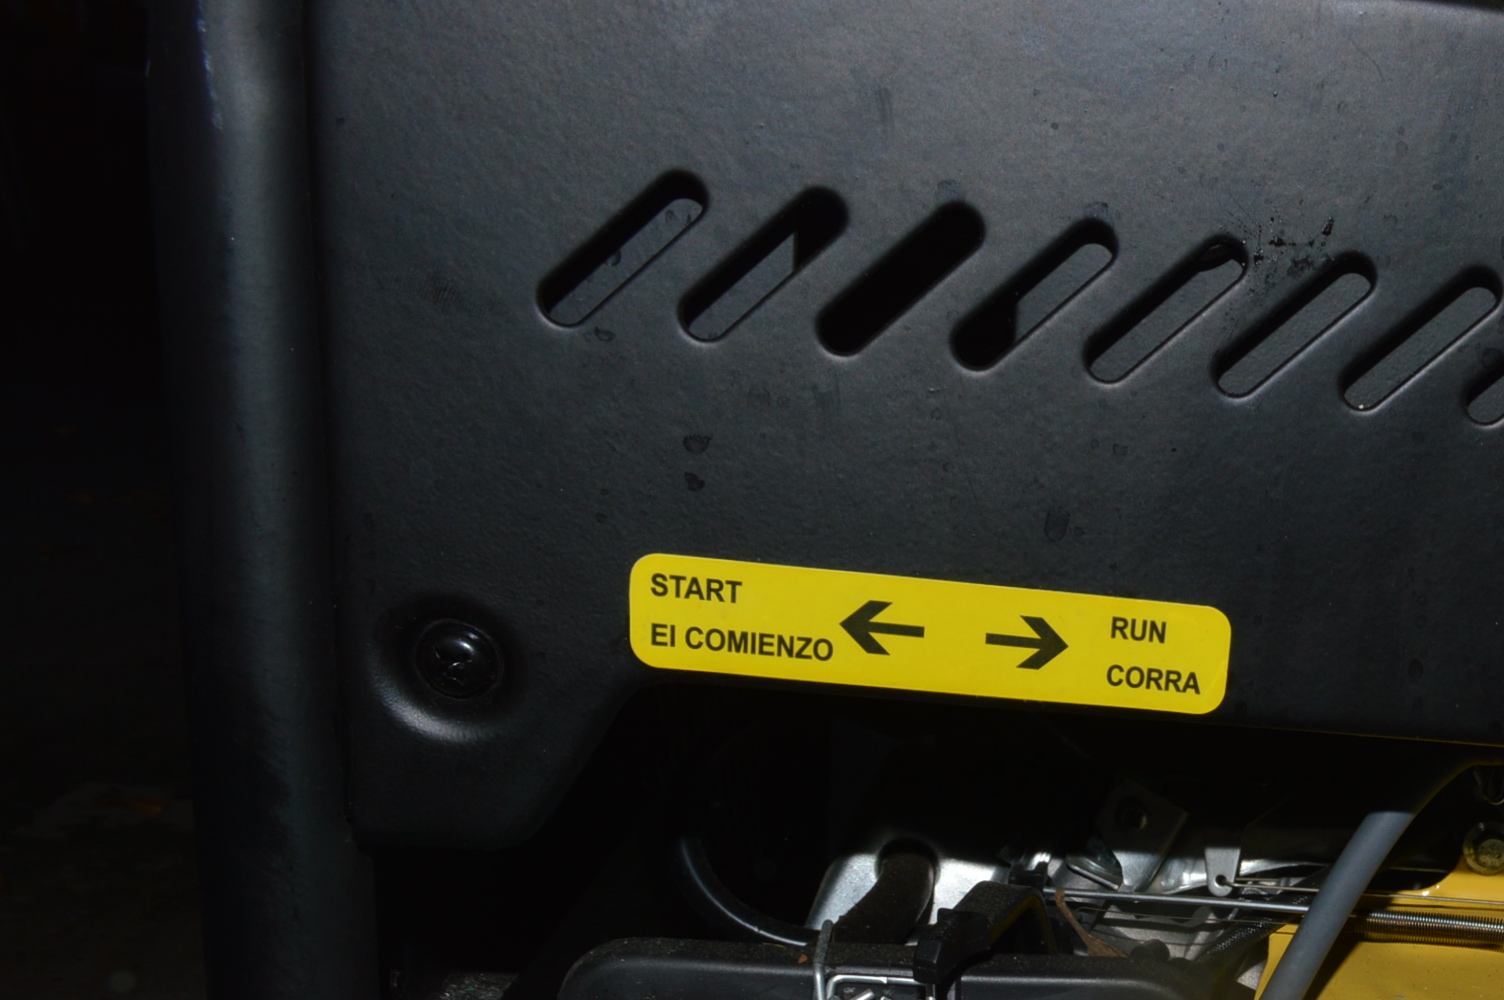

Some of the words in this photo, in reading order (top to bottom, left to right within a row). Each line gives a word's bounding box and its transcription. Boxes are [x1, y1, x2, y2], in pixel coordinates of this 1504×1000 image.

[650, 573, 743, 603] START
[685, 626, 834, 661] COMIENZO
[1110, 616, 1167, 644] RUN
[1106, 664, 1201, 694] CORRA
